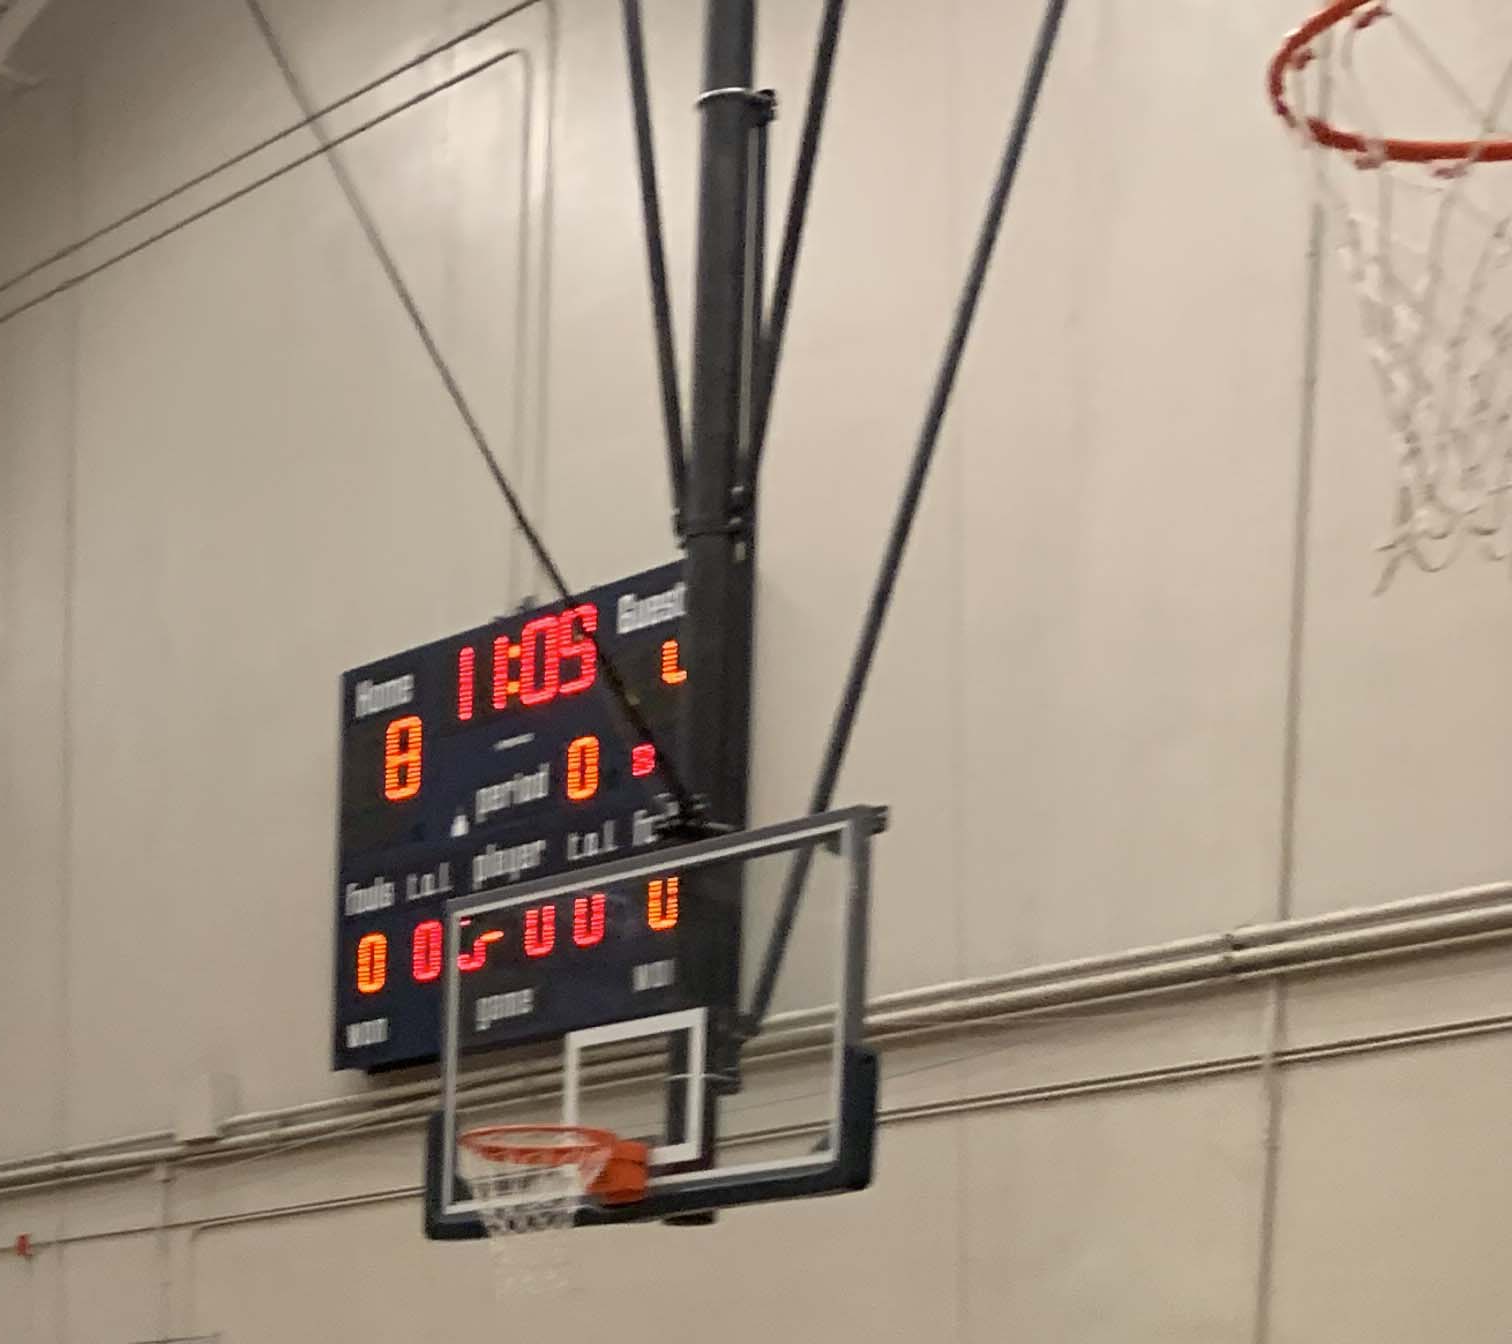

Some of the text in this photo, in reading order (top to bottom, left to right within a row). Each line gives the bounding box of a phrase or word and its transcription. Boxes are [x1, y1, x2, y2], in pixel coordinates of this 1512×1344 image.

[385, 715, 423, 800] 8
[567, 735, 600, 800] 0
[358, 932, 388, 994] 0
